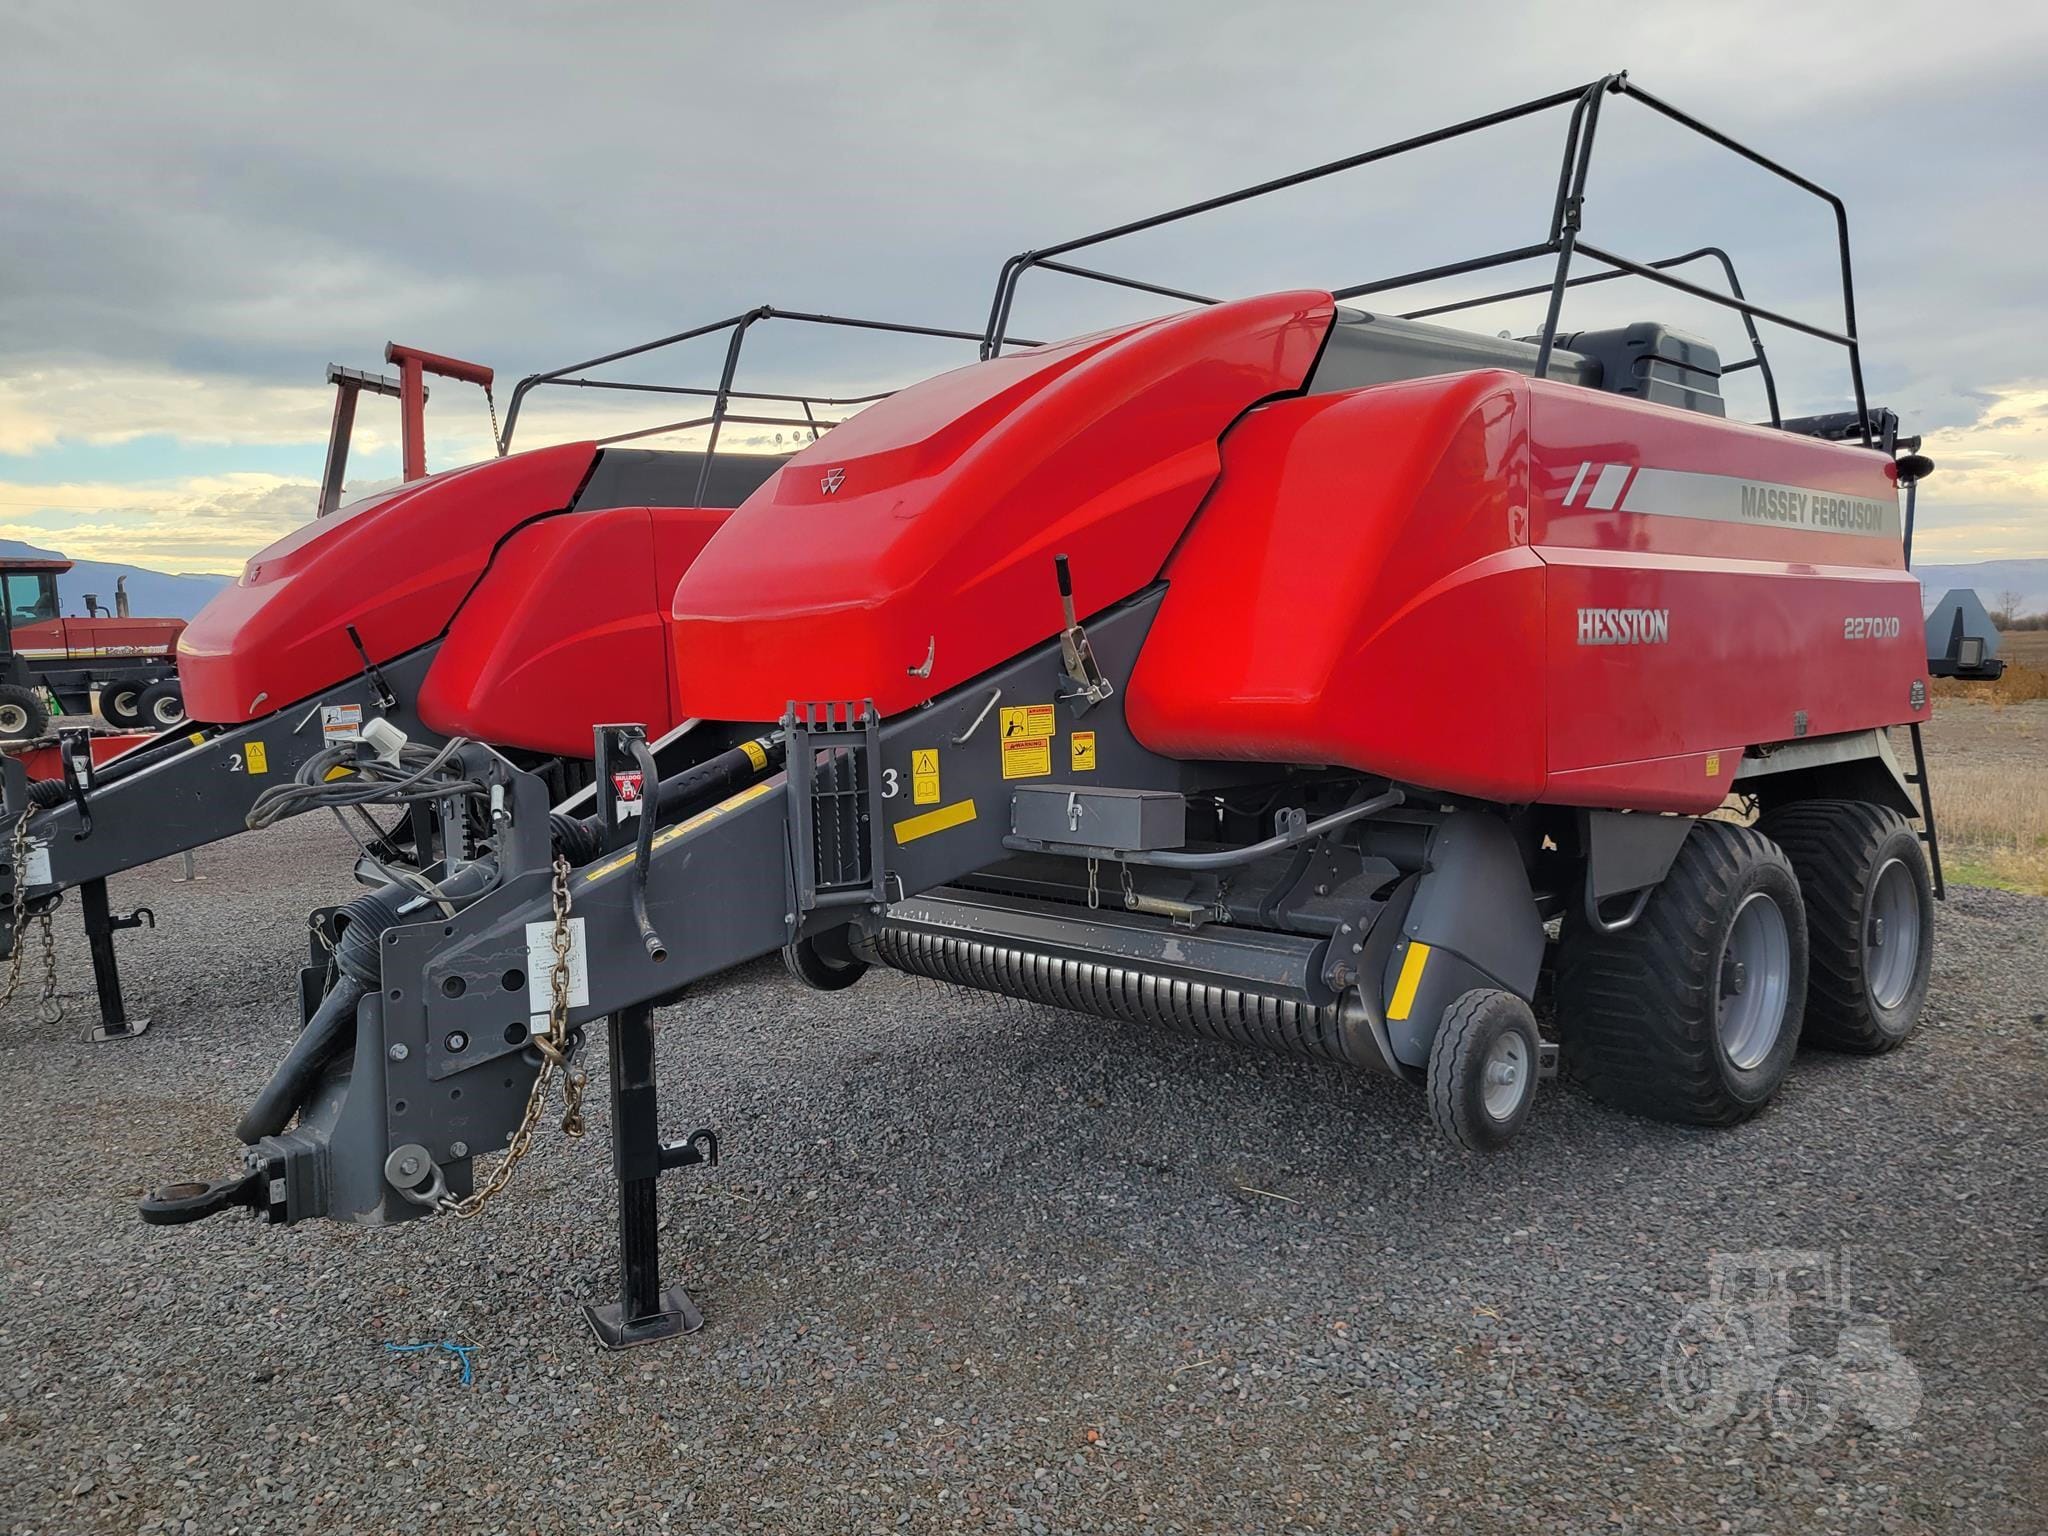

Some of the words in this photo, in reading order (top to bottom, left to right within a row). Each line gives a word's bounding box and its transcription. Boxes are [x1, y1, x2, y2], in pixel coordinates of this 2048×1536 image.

[1741, 485, 1807, 523] MASSEY
[1811, 496, 1882, 531] FERGUSON
[1577, 608, 1669, 645] HESSTON
[1844, 617, 1900, 639] 2270XD
[1014, 740, 1042, 749] WARNING
[229, 754, 244, 772] 2
[881, 768, 899, 798] 3
